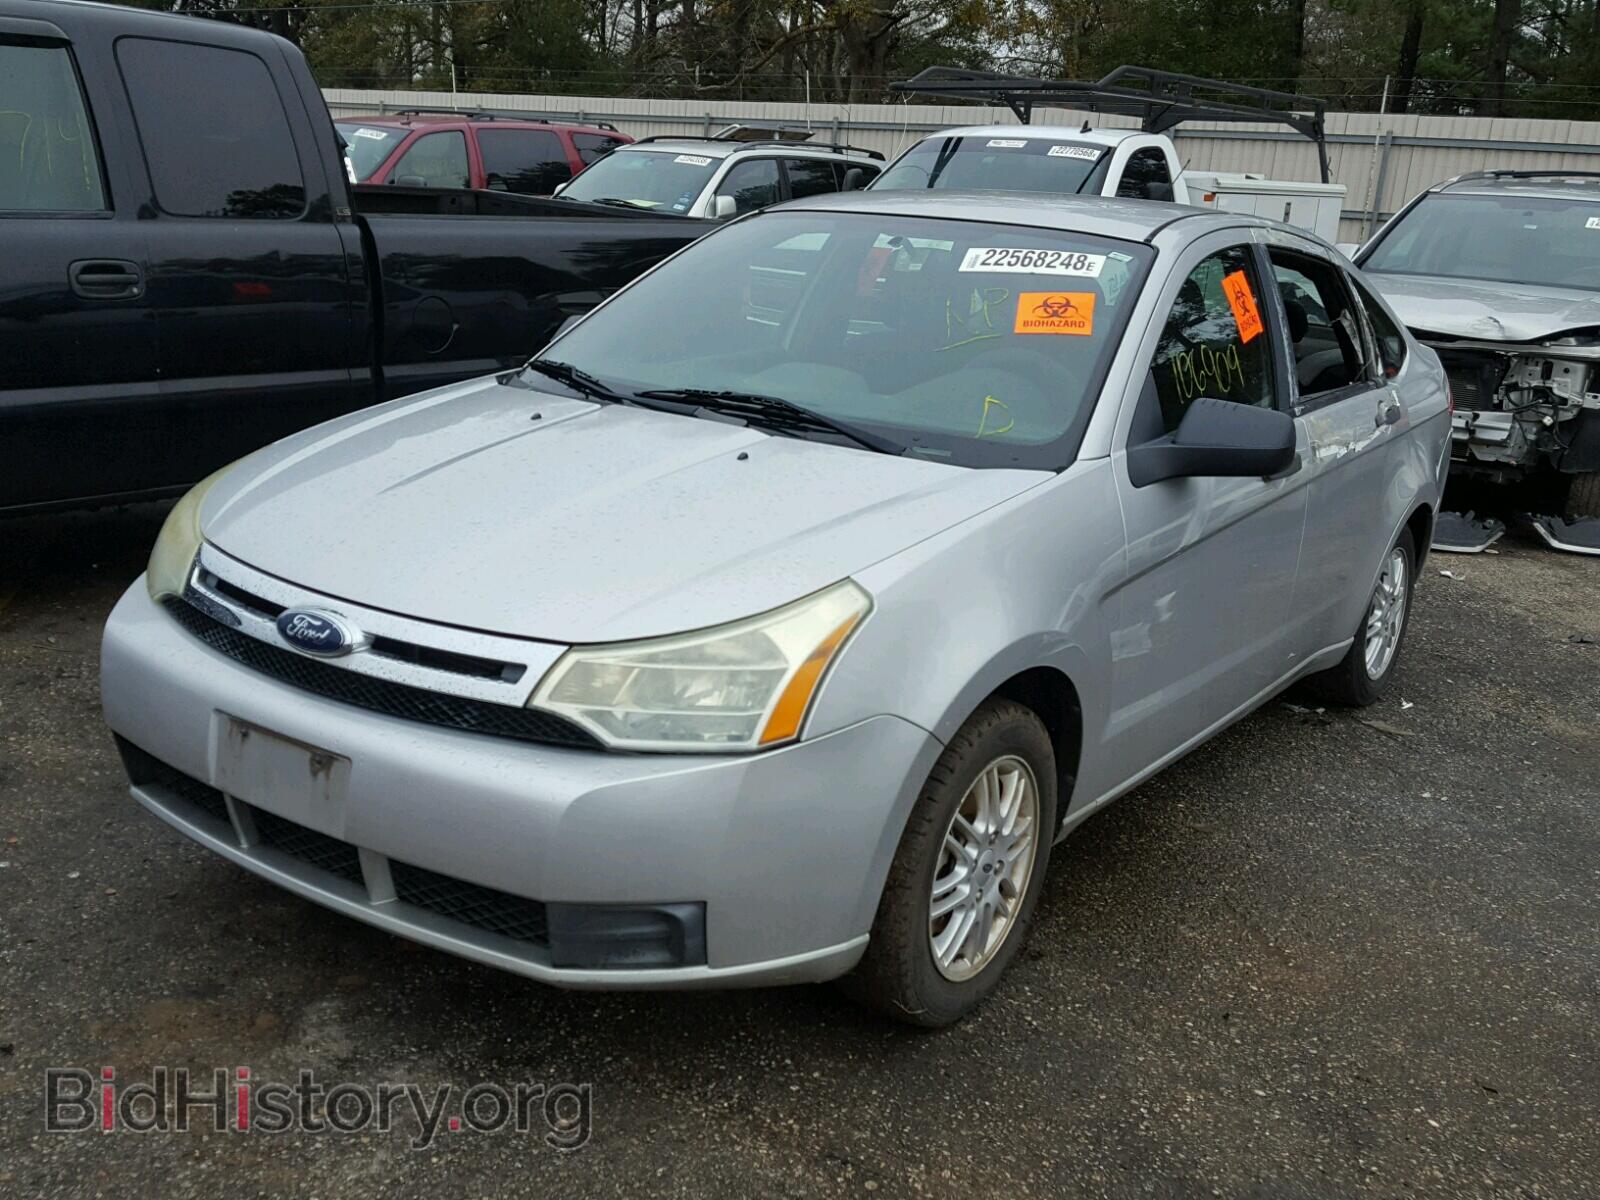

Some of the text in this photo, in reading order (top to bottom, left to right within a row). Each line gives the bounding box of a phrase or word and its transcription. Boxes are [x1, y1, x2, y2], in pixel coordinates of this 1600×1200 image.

[1022, 319, 1086, 329] BIOHAZARD
[975, 395, 1014, 438] D
[286, 613, 332, 641] Ford
